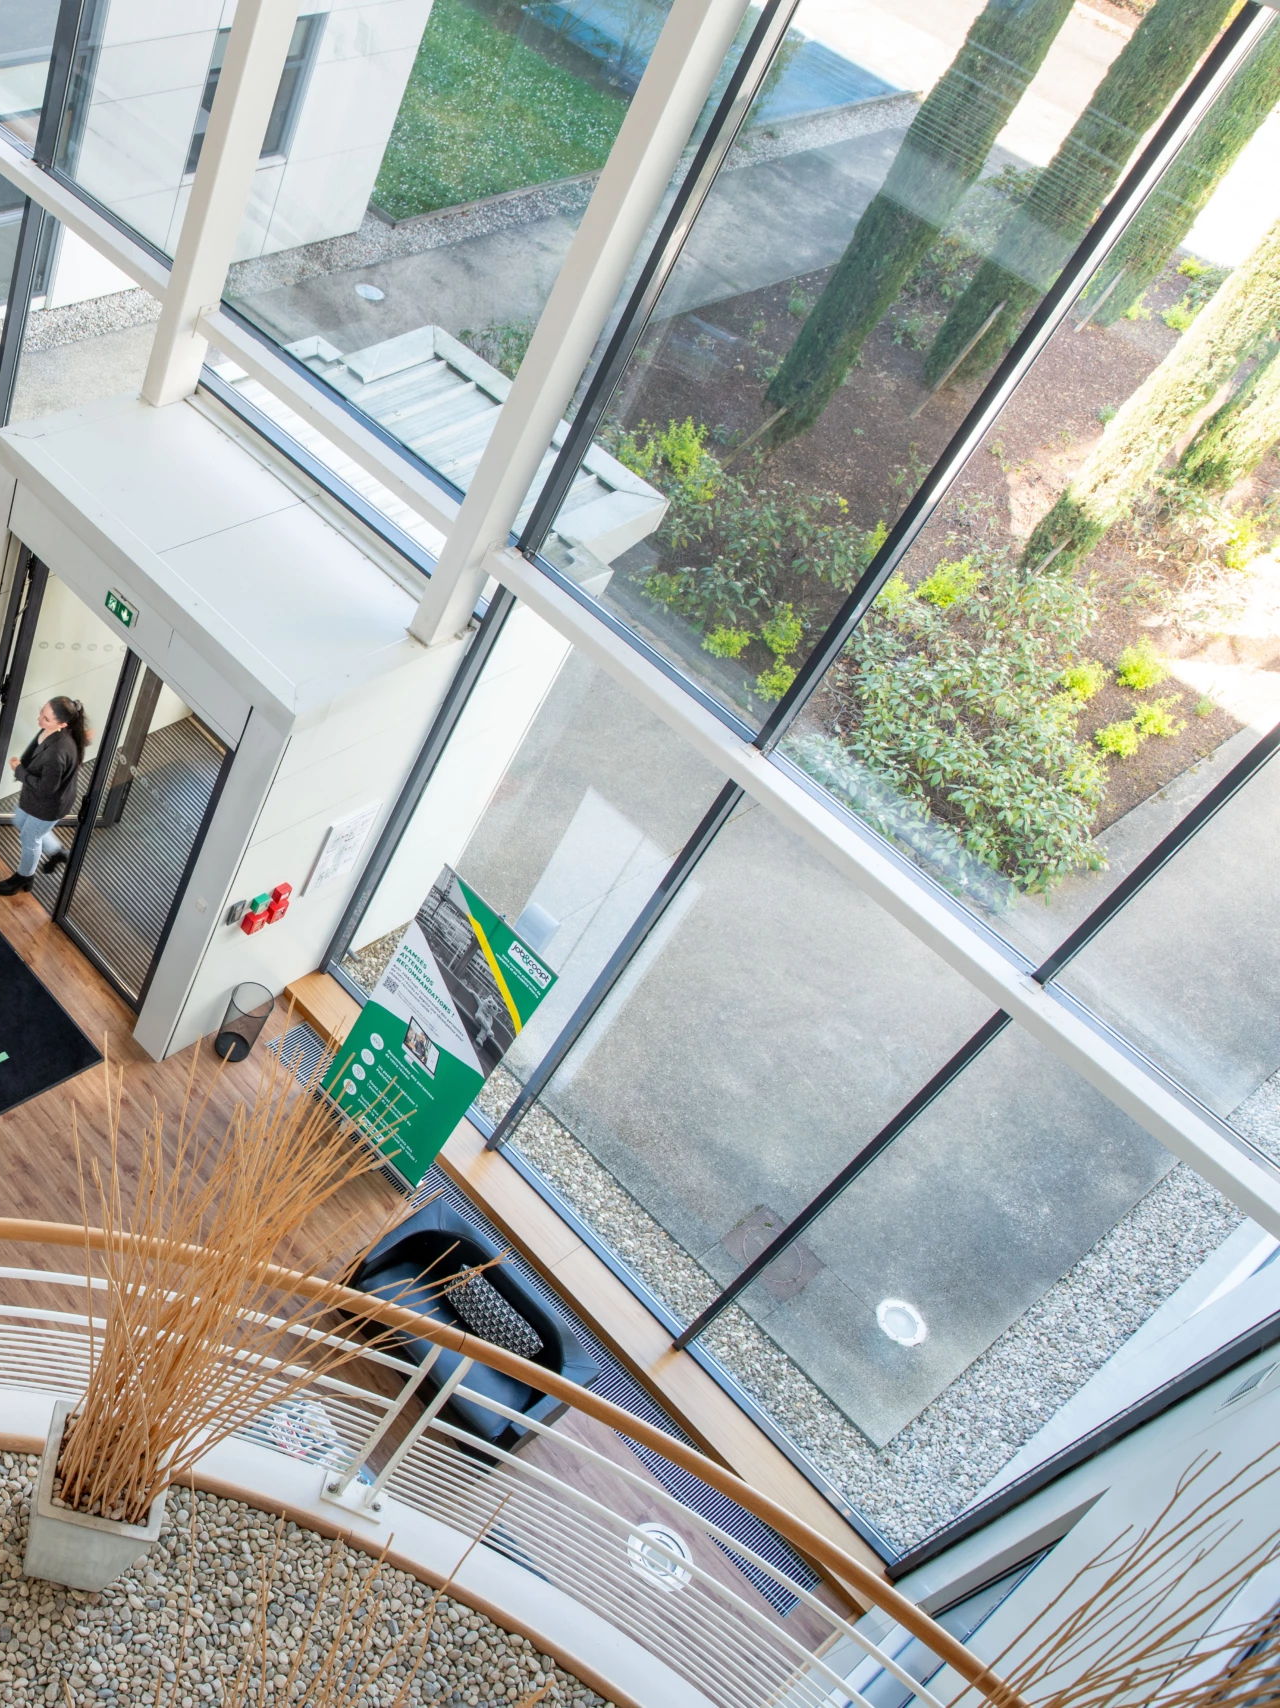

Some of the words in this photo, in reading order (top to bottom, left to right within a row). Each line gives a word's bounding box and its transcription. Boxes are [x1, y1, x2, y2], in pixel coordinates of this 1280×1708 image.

[399, 949, 423, 975] ATTEND
[421, 972, 434, 986] VOS
[403, 942, 428, 970] RAMSÈS
[396, 956, 452, 1015] RECOMMANDATIONS
